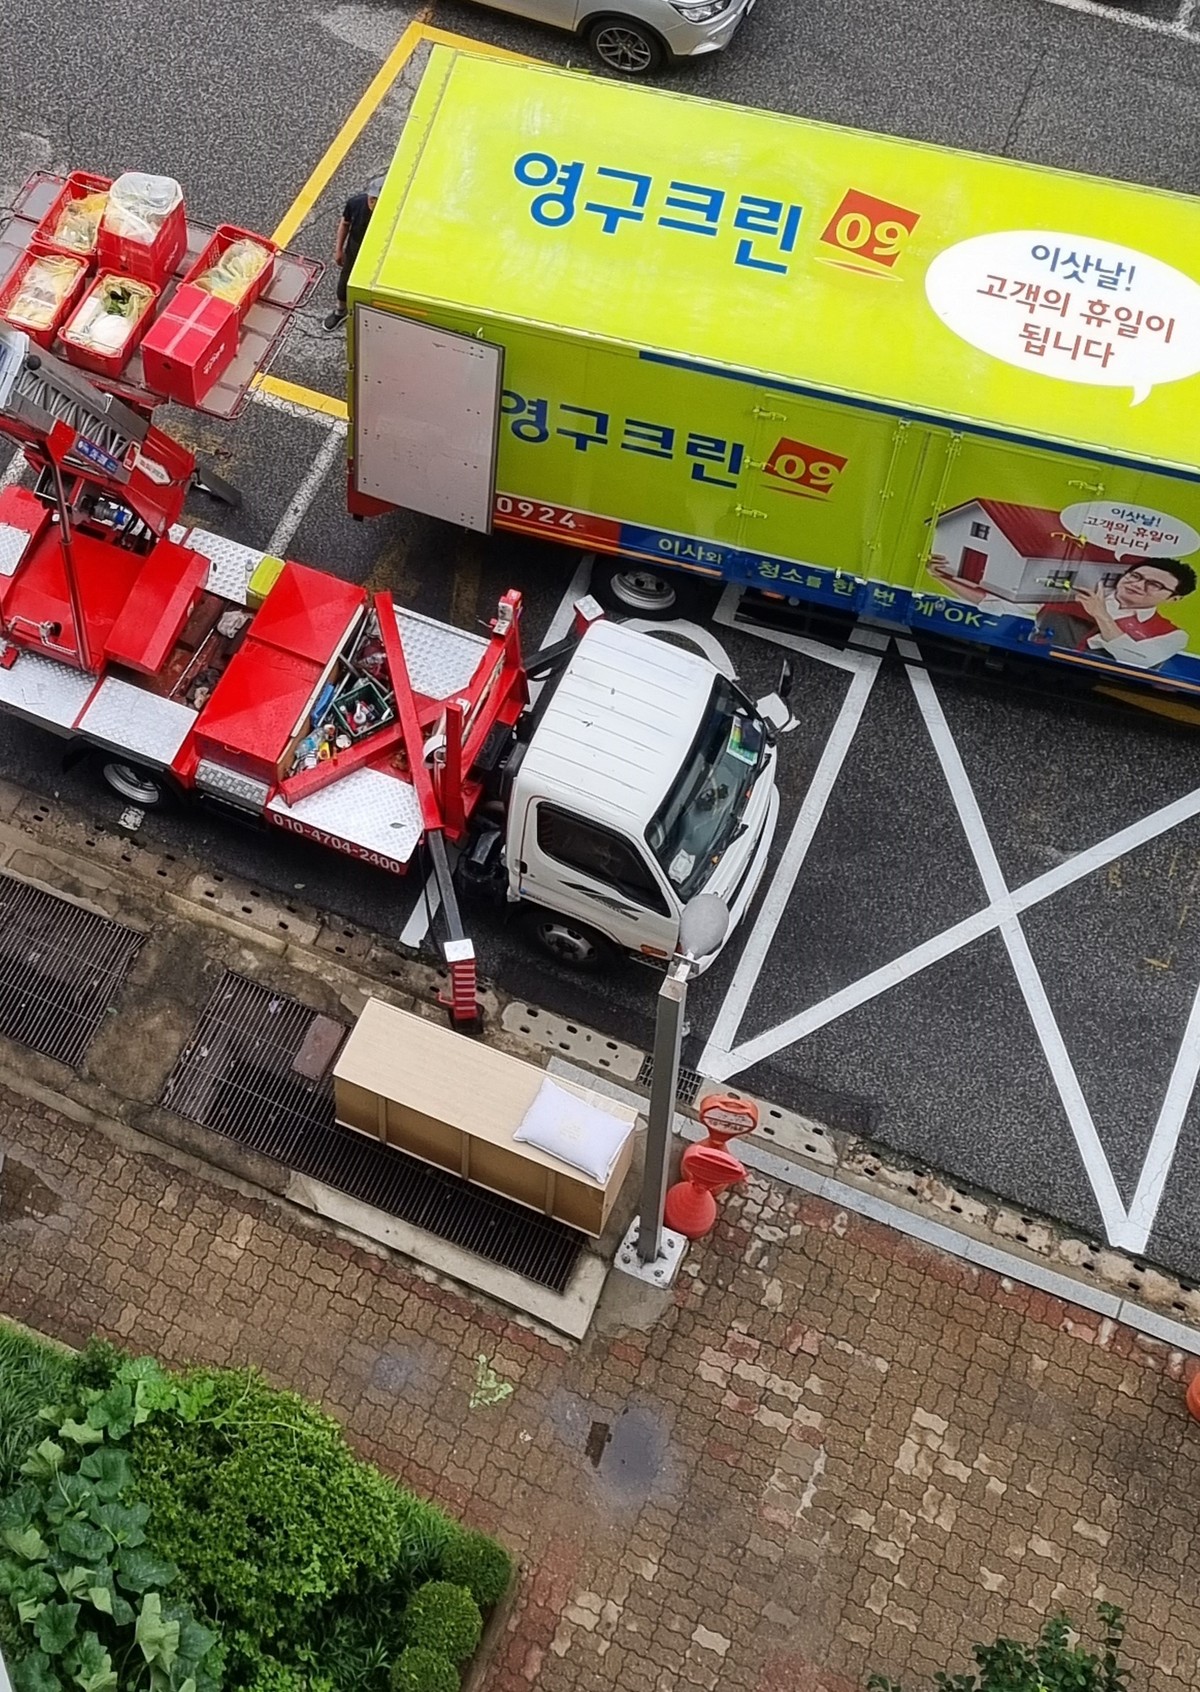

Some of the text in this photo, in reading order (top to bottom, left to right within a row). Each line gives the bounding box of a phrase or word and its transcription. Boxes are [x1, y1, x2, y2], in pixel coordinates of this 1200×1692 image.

[513, 151, 803, 275] 영구크린
[1030, 244, 1136, 292] 이삿날!
[976, 273, 1176, 344] 고객의 휴일이
[1018, 322, 1116, 368] 됩니다
[501, 389, 745, 490] 영구크린
[1083, 516, 1180, 545] 고객의 휴일이
[1111, 507, 1162, 528] 이삿날!
[658, 537, 723, 565] 이사와
[1104, 533, 1151, 551] 됩니다
[272, 812, 401, 874] 010-4704-2400
